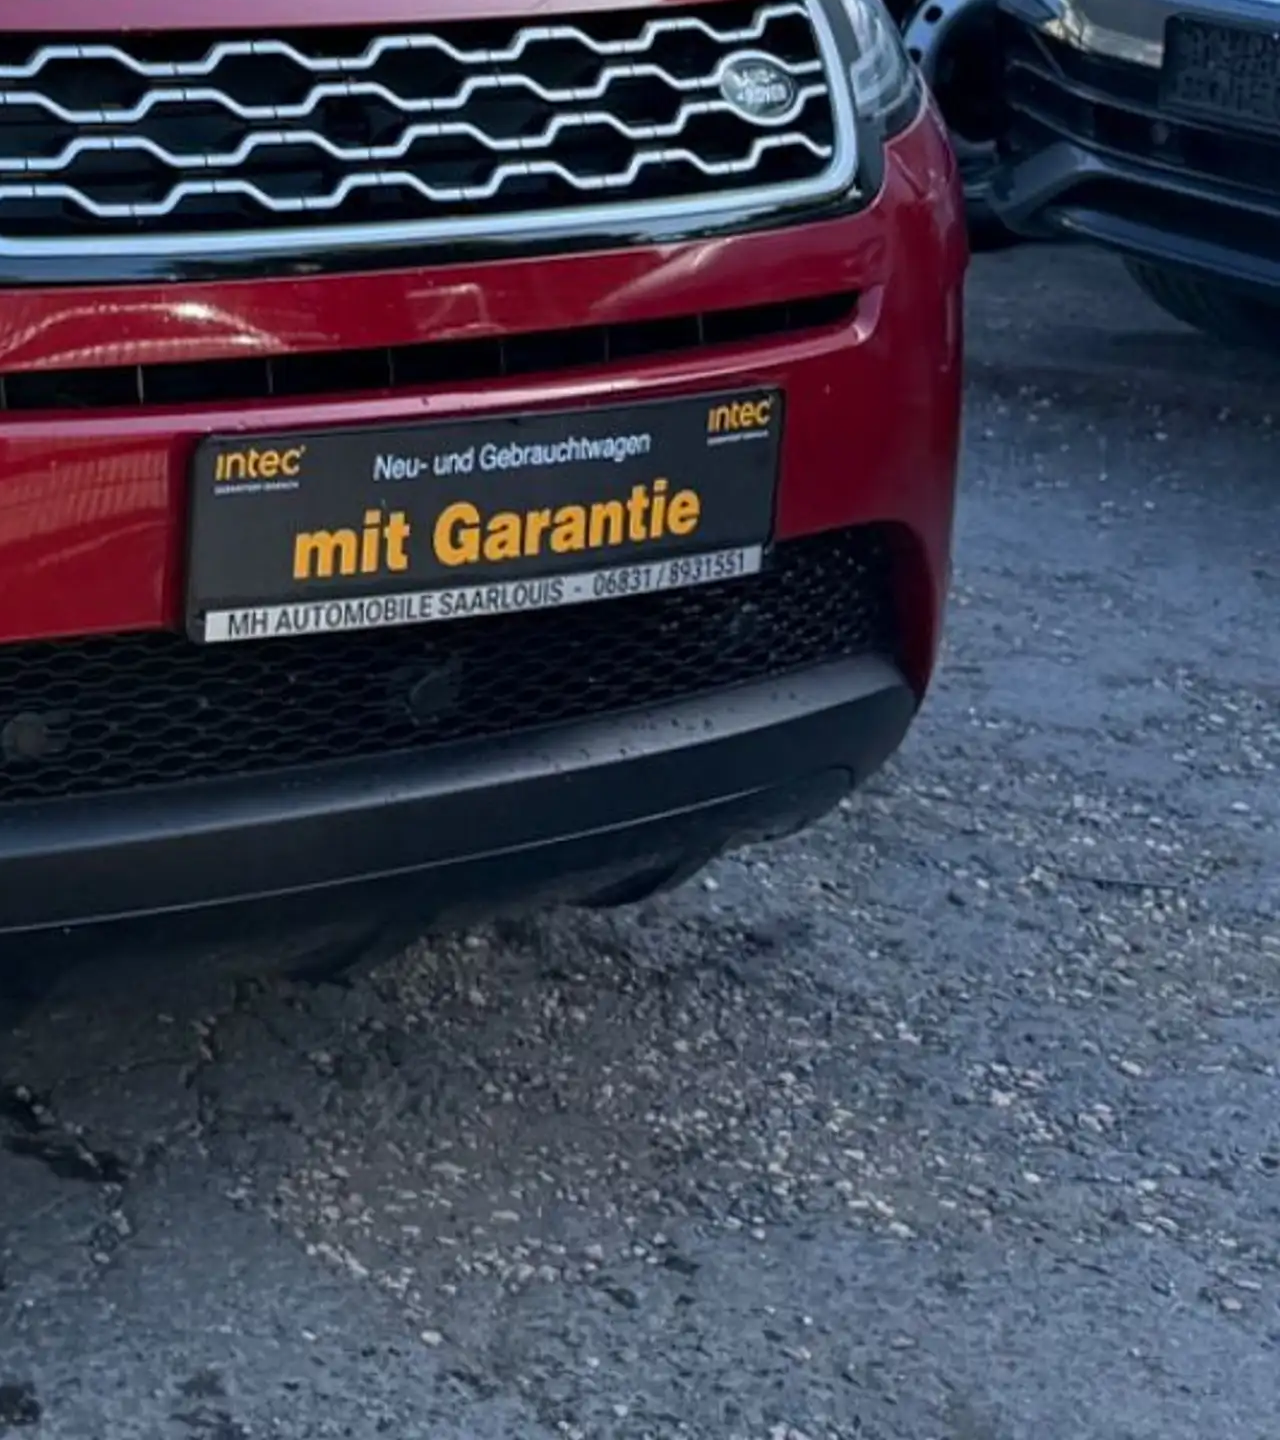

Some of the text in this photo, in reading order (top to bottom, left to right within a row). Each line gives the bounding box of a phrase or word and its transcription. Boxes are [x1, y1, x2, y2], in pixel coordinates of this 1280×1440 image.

[707, 399, 771, 433] intec
[214, 446, 302, 481] intec
[373, 433, 651, 481] Neu- und Gebrauchtwagen
[293, 479, 700, 579] mit Garantie
[227, 613, 269, 637] MH
[275, 595, 432, 633] AUTOMOBILE
[439, 578, 564, 615] SAARLOUIS
